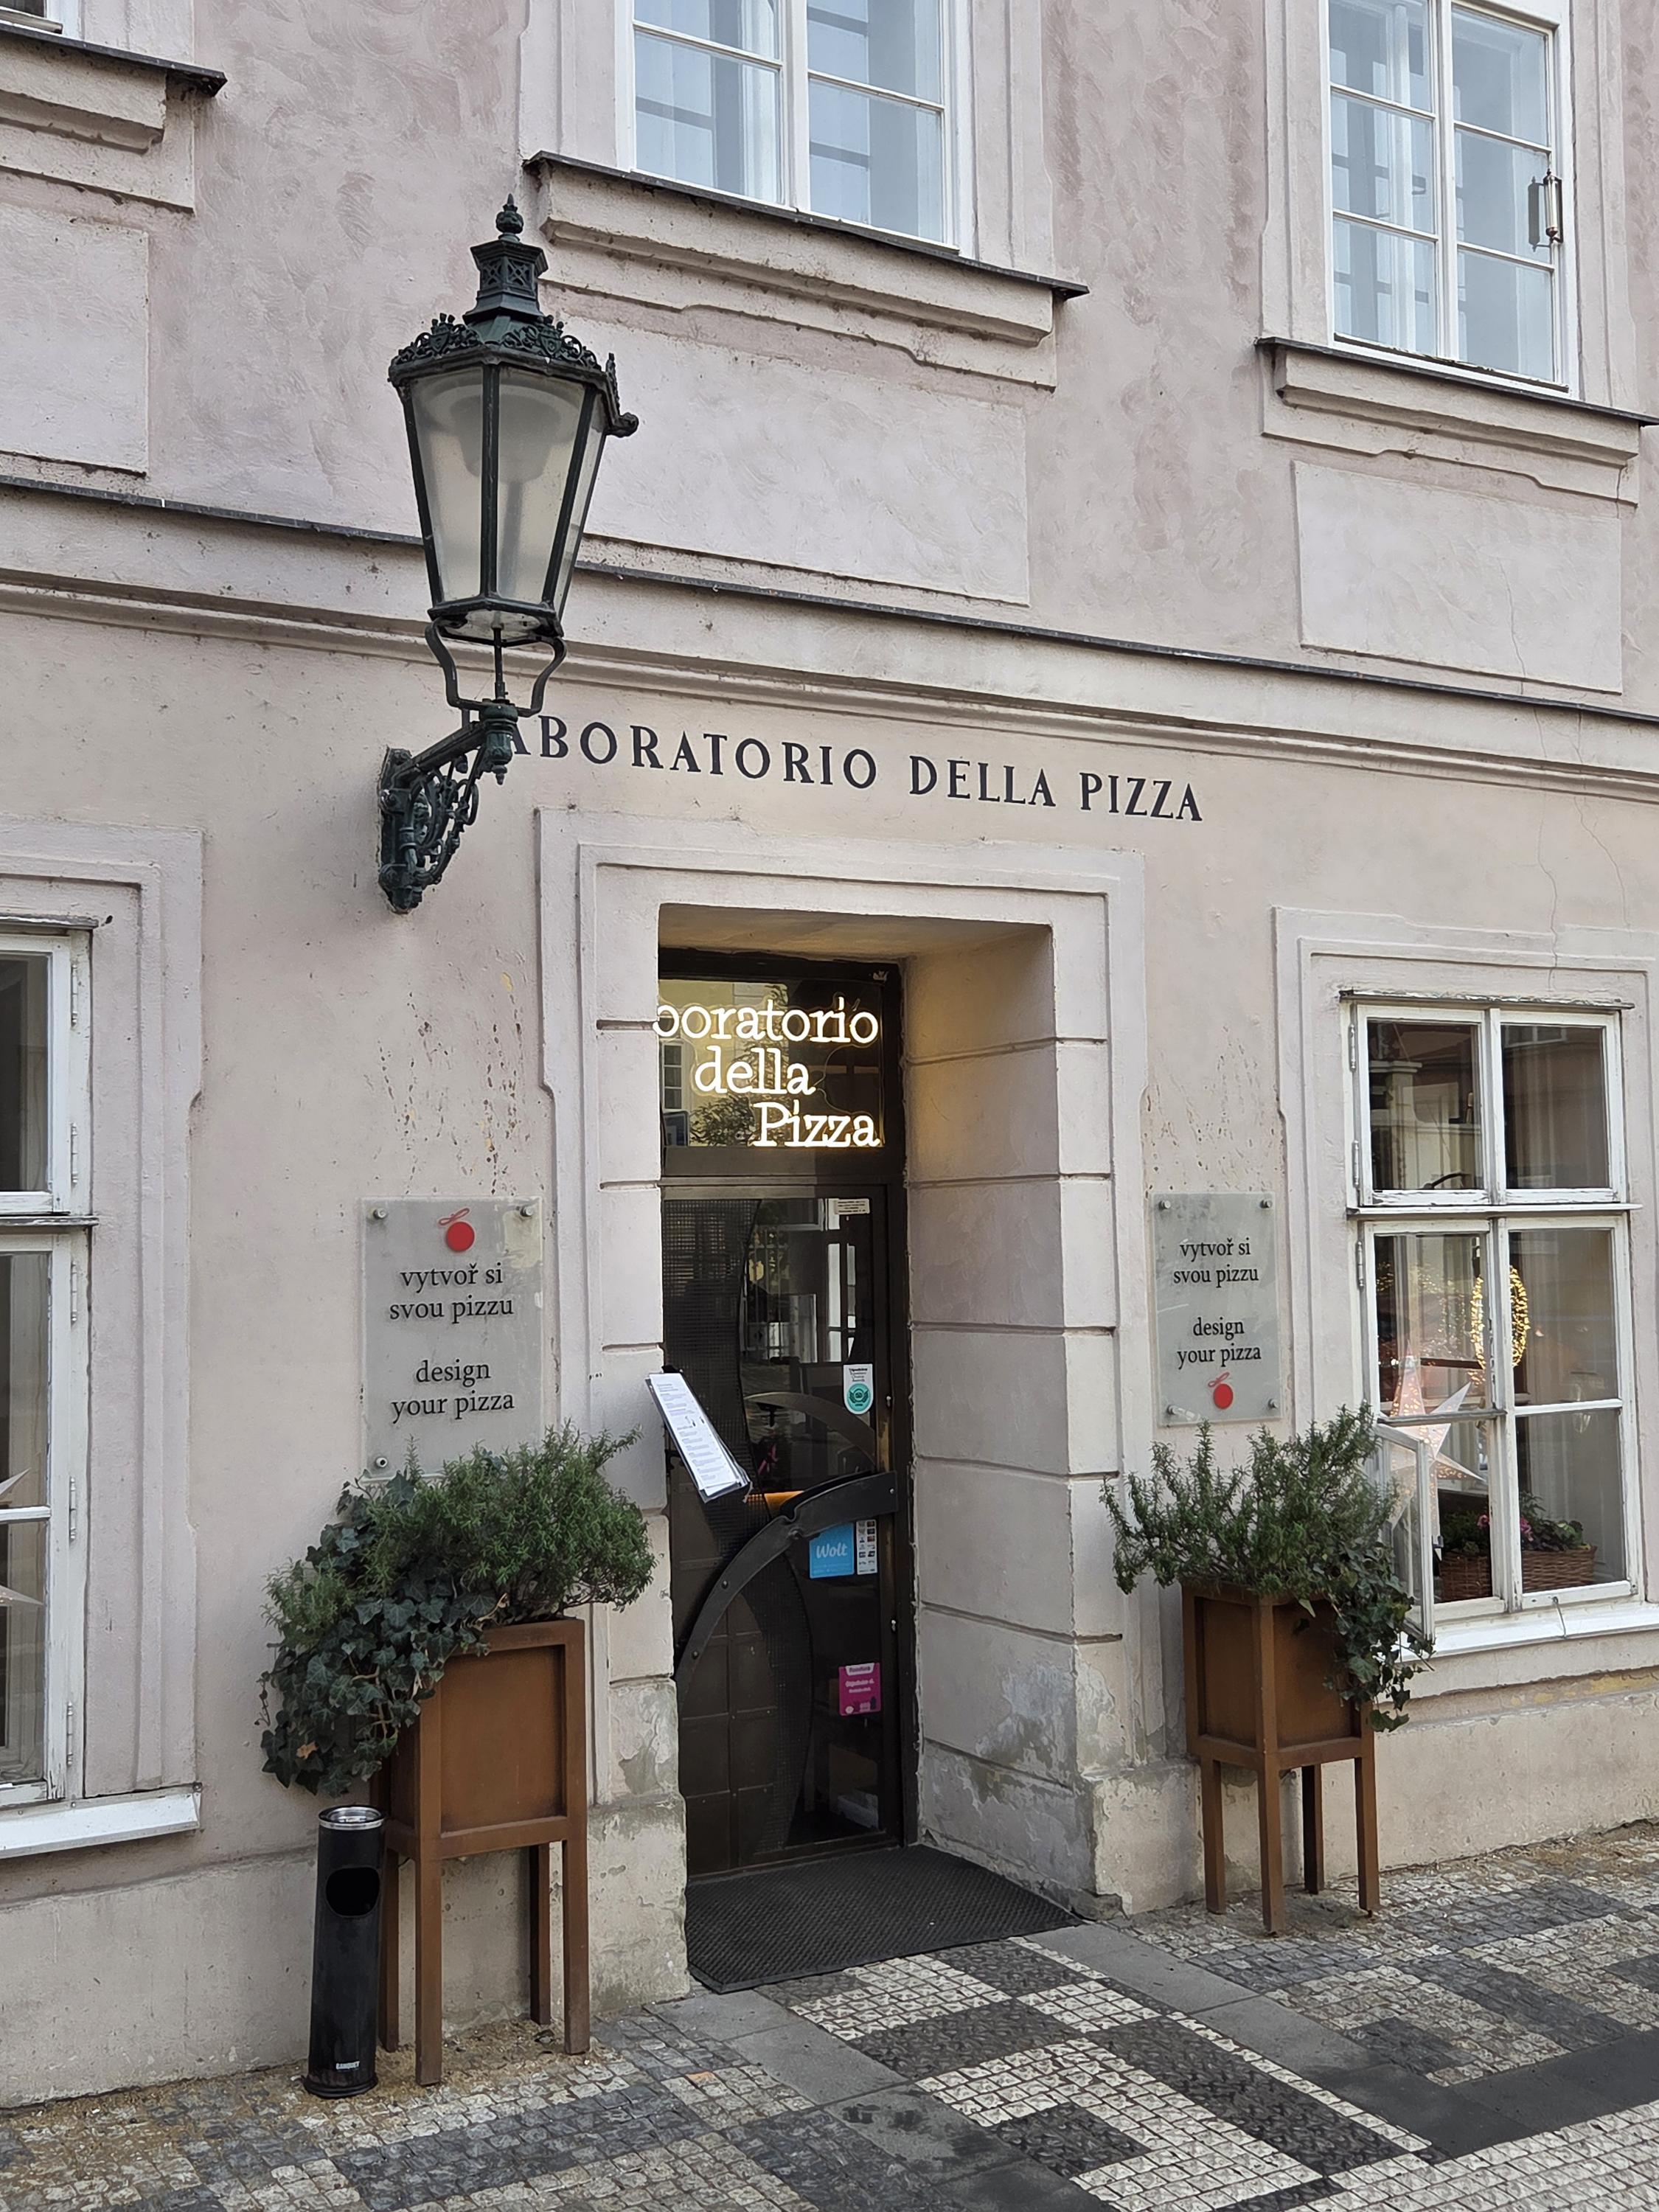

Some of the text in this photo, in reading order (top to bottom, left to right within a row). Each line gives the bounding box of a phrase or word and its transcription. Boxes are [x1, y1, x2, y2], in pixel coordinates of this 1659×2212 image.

[909, 755, 1057, 807] DELLA
[1079, 772, 1203, 821] PIZZA
[695, 1046, 816, 1095] della
[752, 1099, 881, 1147] Pizza
[1180, 1237, 1251, 1262] vytvoř si
[400, 1262, 503, 1294] vytvoř si
[1173, 1264, 1259, 1288] svou pizzu
[389, 1294, 514, 1324] svou pizzu
[1192, 1316, 1245, 1341] design
[1177, 1343, 1262, 1370] your pizza
[415, 1358, 491, 1388] design
[391, 1389, 515, 1425] your pizza
[815, 1542, 848, 1559] Wolt
